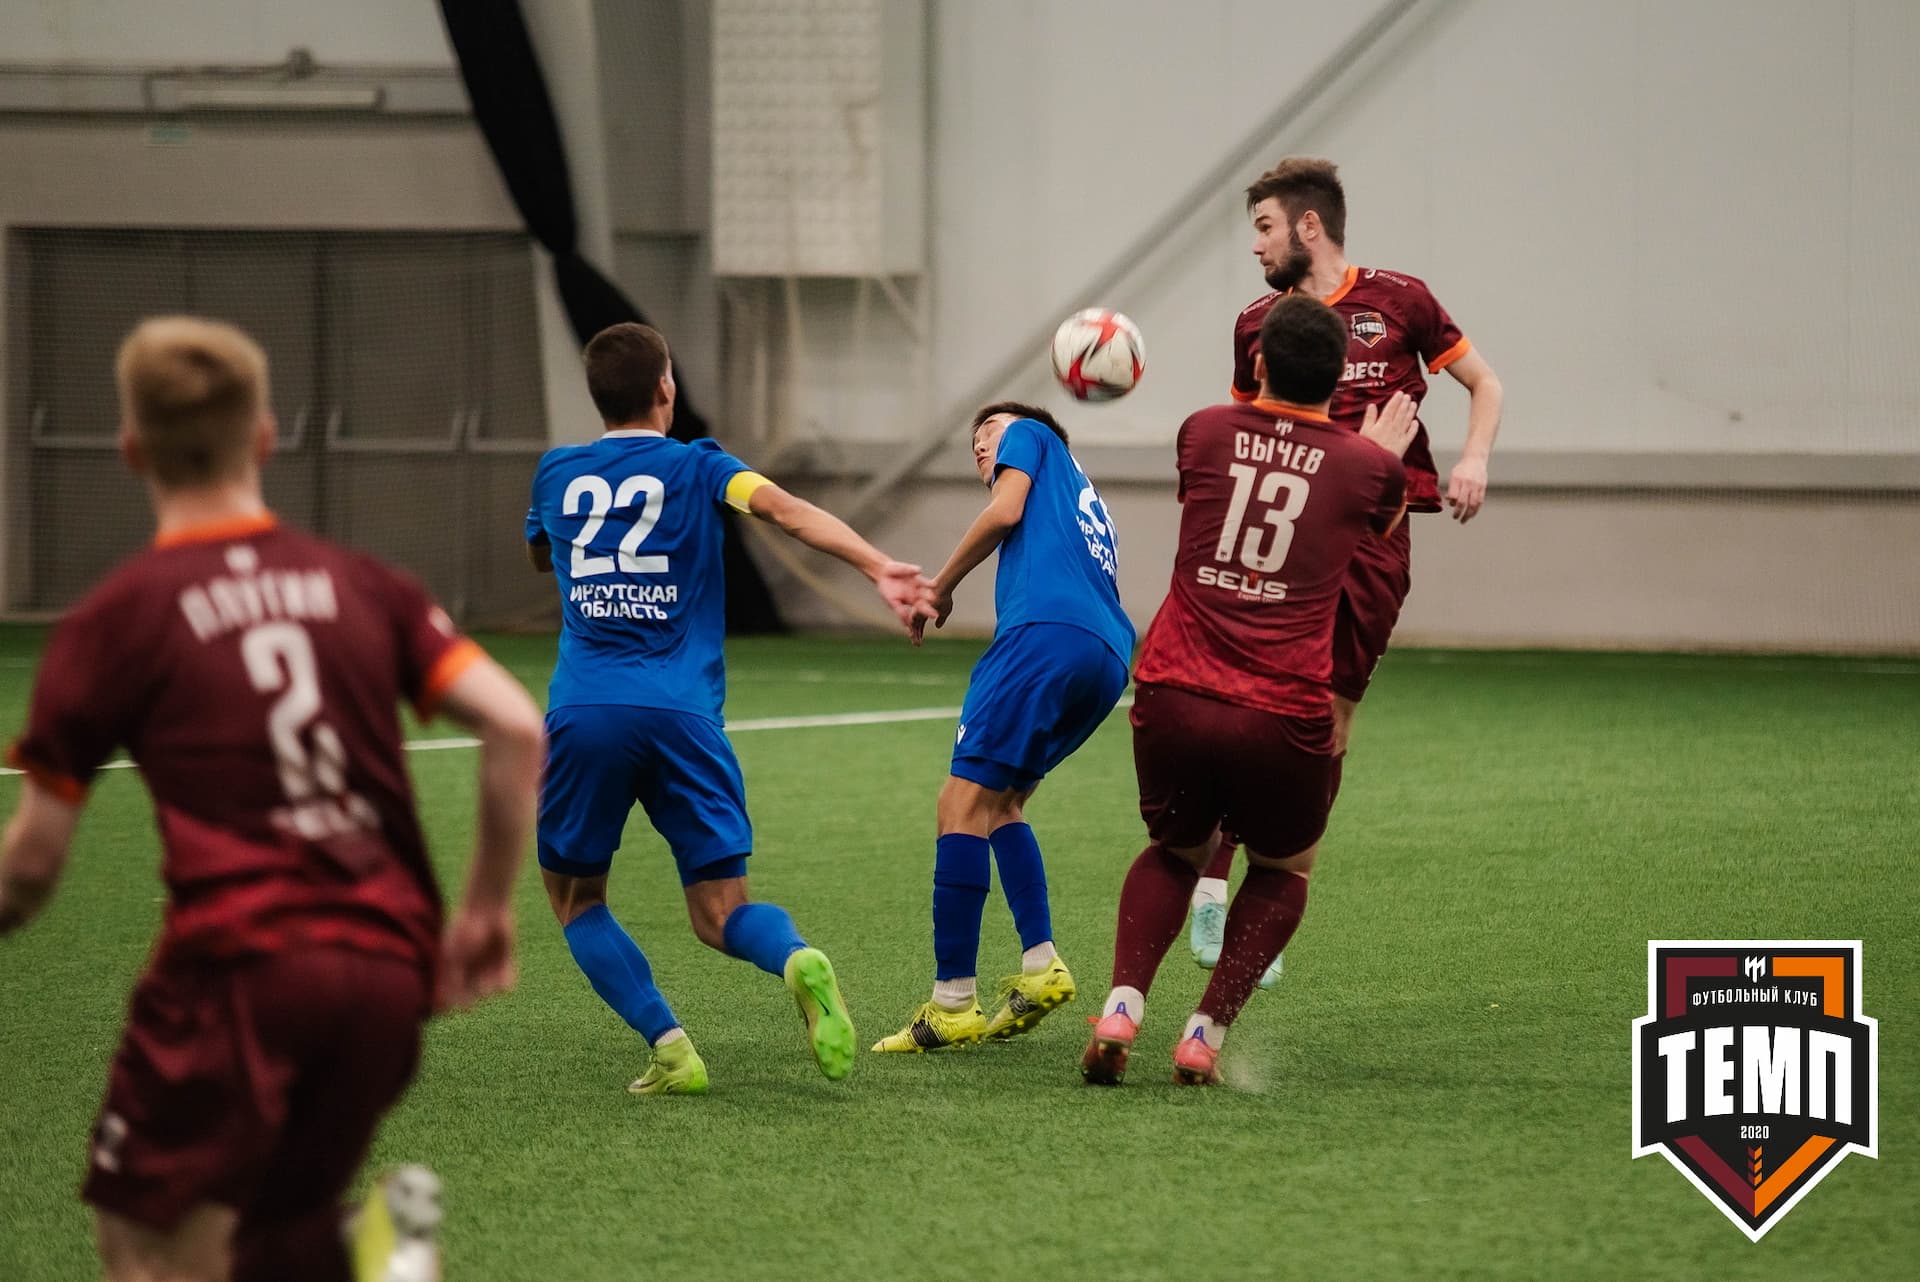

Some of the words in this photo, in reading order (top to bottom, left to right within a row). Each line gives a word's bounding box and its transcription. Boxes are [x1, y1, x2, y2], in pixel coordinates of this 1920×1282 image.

[1235, 432, 1325, 475] СЫЧЕВ
[562, 474, 669, 579] 22
[1214, 462, 1310, 574] 13
[1196, 566, 1288, 600] SEUS
[580, 600, 668, 620] ОБЛАСТЬ
